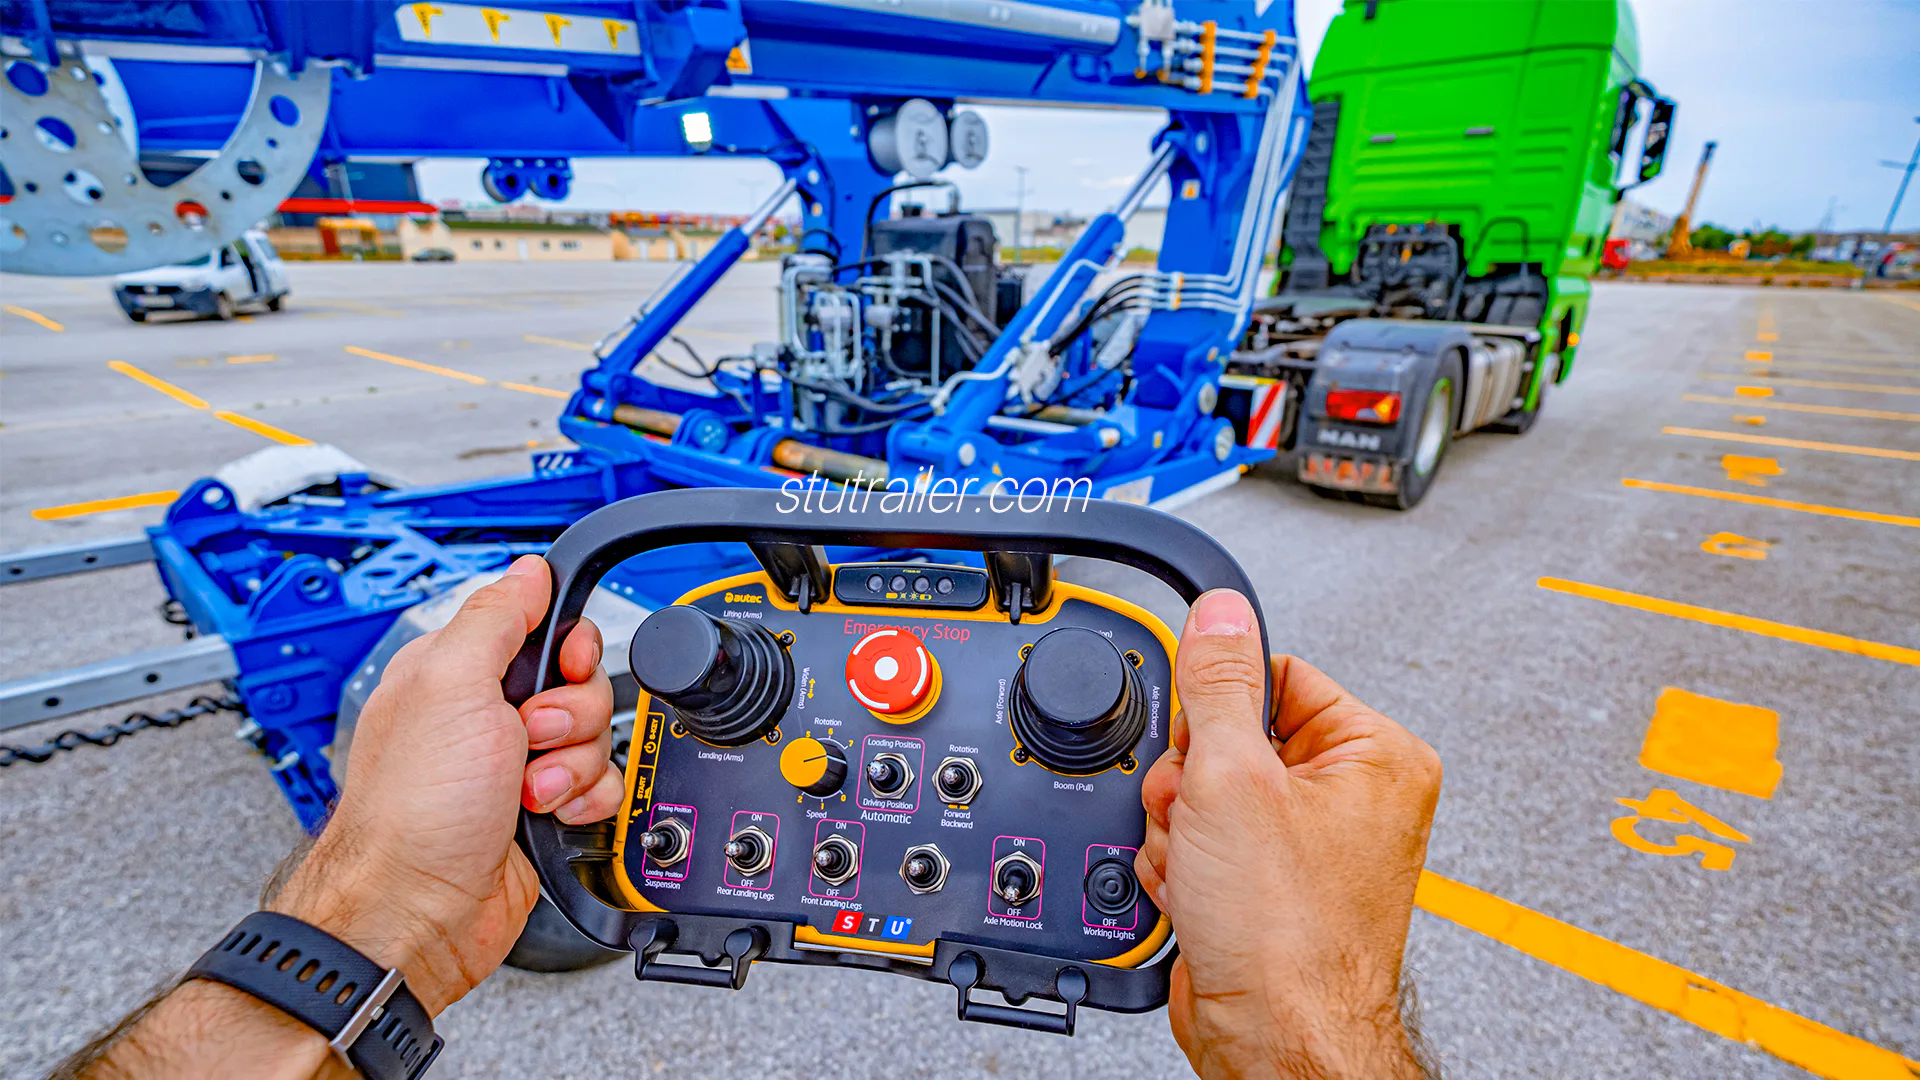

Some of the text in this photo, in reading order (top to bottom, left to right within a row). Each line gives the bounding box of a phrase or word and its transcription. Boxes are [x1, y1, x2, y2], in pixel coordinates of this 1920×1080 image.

[734, 594, 762, 604] autec
[723, 610, 763, 620] Lifting (Arms)
[932, 623, 971, 644] Stop
[797, 667, 810, 709] Widen (Arms)
[814, 717, 842, 727] Rotation
[868, 738, 921, 750] Loading Position
[949, 744, 979, 754] Rotation
[698, 751, 744, 762] Landing (Arms)
[637, 776, 646, 799] START
[1053, 781, 1094, 792] Boom (Pull)
[863, 798, 914, 810] Driving Position
[658, 805, 692, 814] Driving Position
[806, 809, 827, 819] Speed
[944, 810, 971, 819] Forward
[751, 814, 763, 822] ON
[860, 810, 912, 824] Automatic
[835, 822, 847, 830] ON
[940, 819, 974, 829] Backward
[1013, 838, 1026, 847] ON
[1107, 847, 1120, 856] ON
[645, 869, 684, 879] Loading Position
[645, 878, 681, 890] Suspension
[740, 879, 754, 888] OFF
[716, 886, 775, 902] Rear Landing Legs
[826, 888, 840, 897] OFF
[801, 896, 862, 911] Front Landing Legs
[1006, 908, 1021, 917] OFF
[983, 917, 1043, 930] Axle Motion Lock
[1102, 918, 1118, 927] OFF
[1082, 926, 1136, 940] Working Lights
